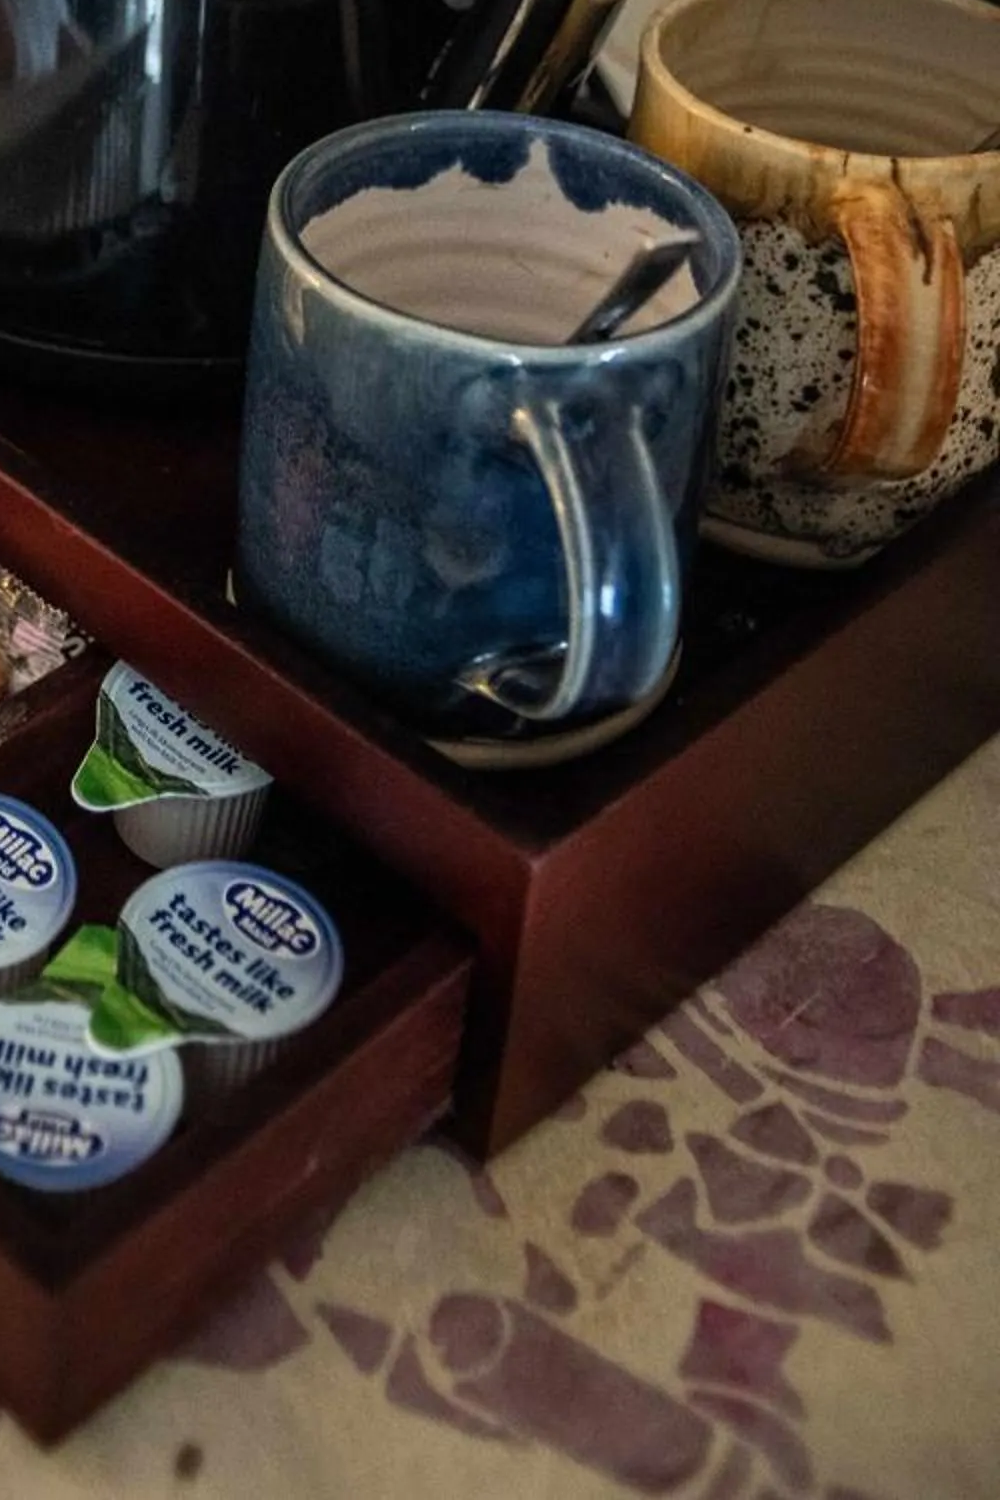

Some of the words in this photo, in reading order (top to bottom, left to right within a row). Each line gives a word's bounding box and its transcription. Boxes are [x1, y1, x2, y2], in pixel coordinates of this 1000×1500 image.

[129, 681, 188, 738] fresh
[187, 734, 241, 775] milk
[169, 893, 246, 965] tastes
[244, 957, 295, 1000] like
[233, 886, 315, 952] Millac
[150, 908, 215, 972] fresh
[213, 969, 274, 1015] milk
[43, 1077, 145, 1113] tastes
[64, 1054, 149, 1088] fresh
